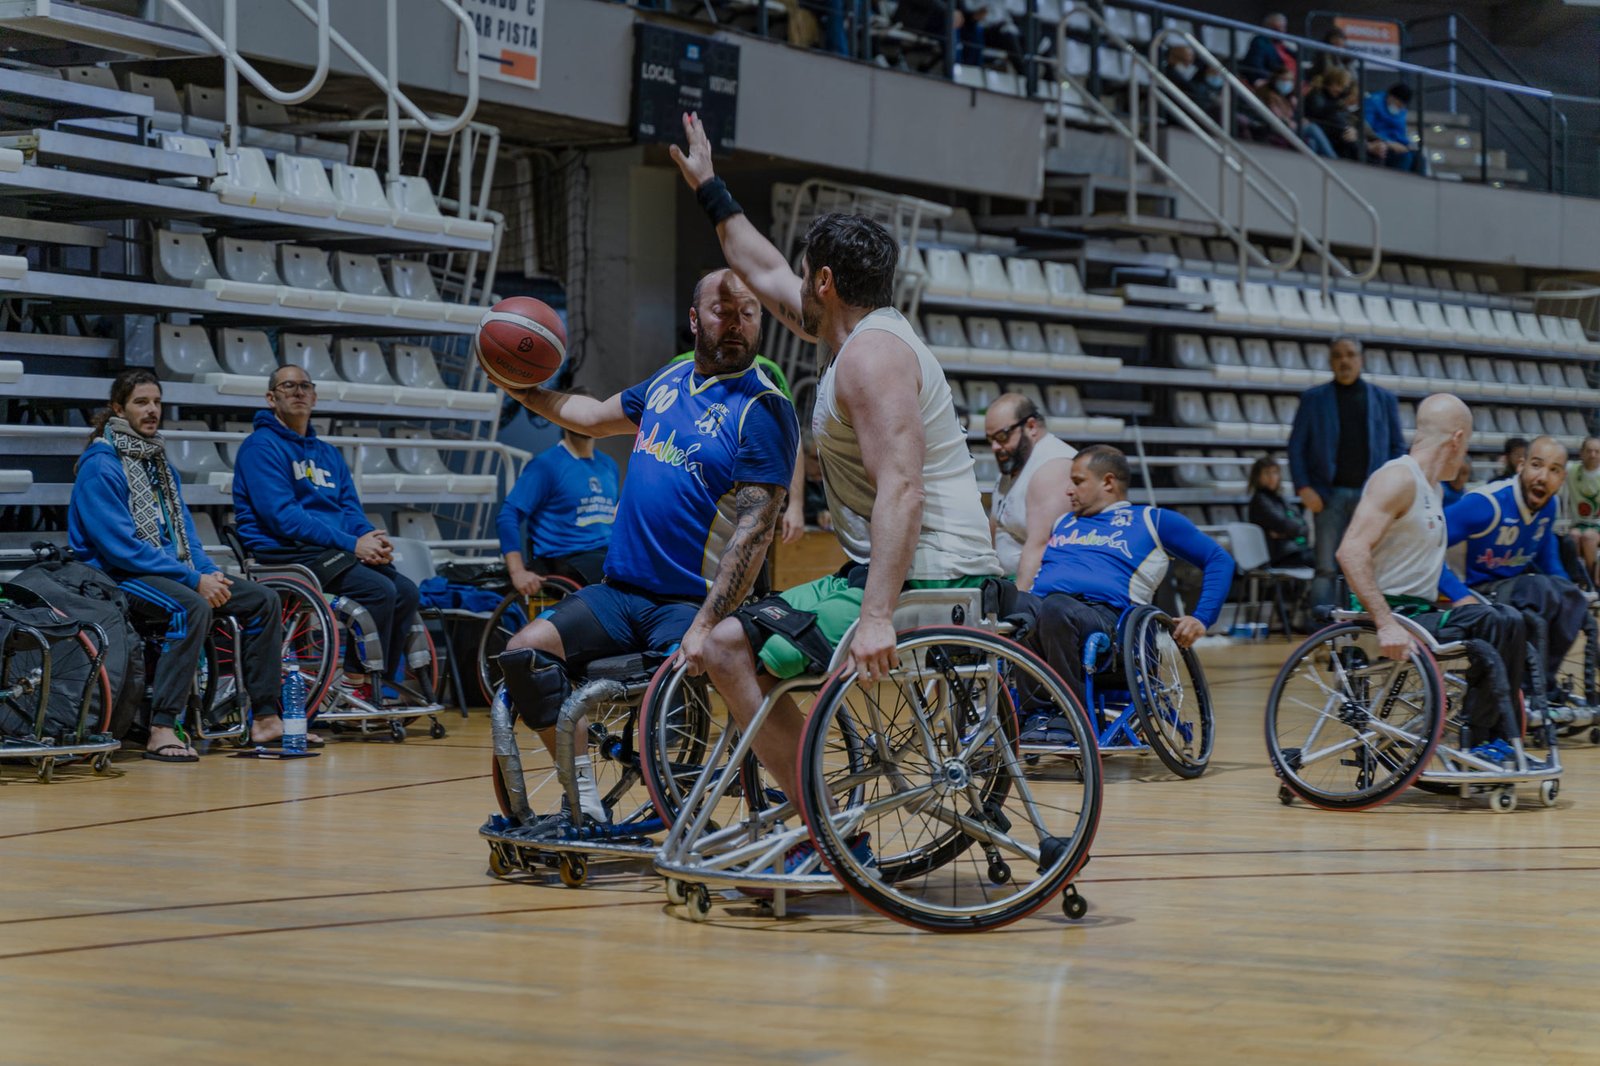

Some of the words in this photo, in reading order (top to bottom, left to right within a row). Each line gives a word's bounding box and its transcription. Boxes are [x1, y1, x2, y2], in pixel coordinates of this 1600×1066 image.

[497, 18, 538, 49] PISTA
[641, 62, 677, 85] LOCAL
[646, 384, 679, 414] 00
[1495, 525, 1520, 546] 10
